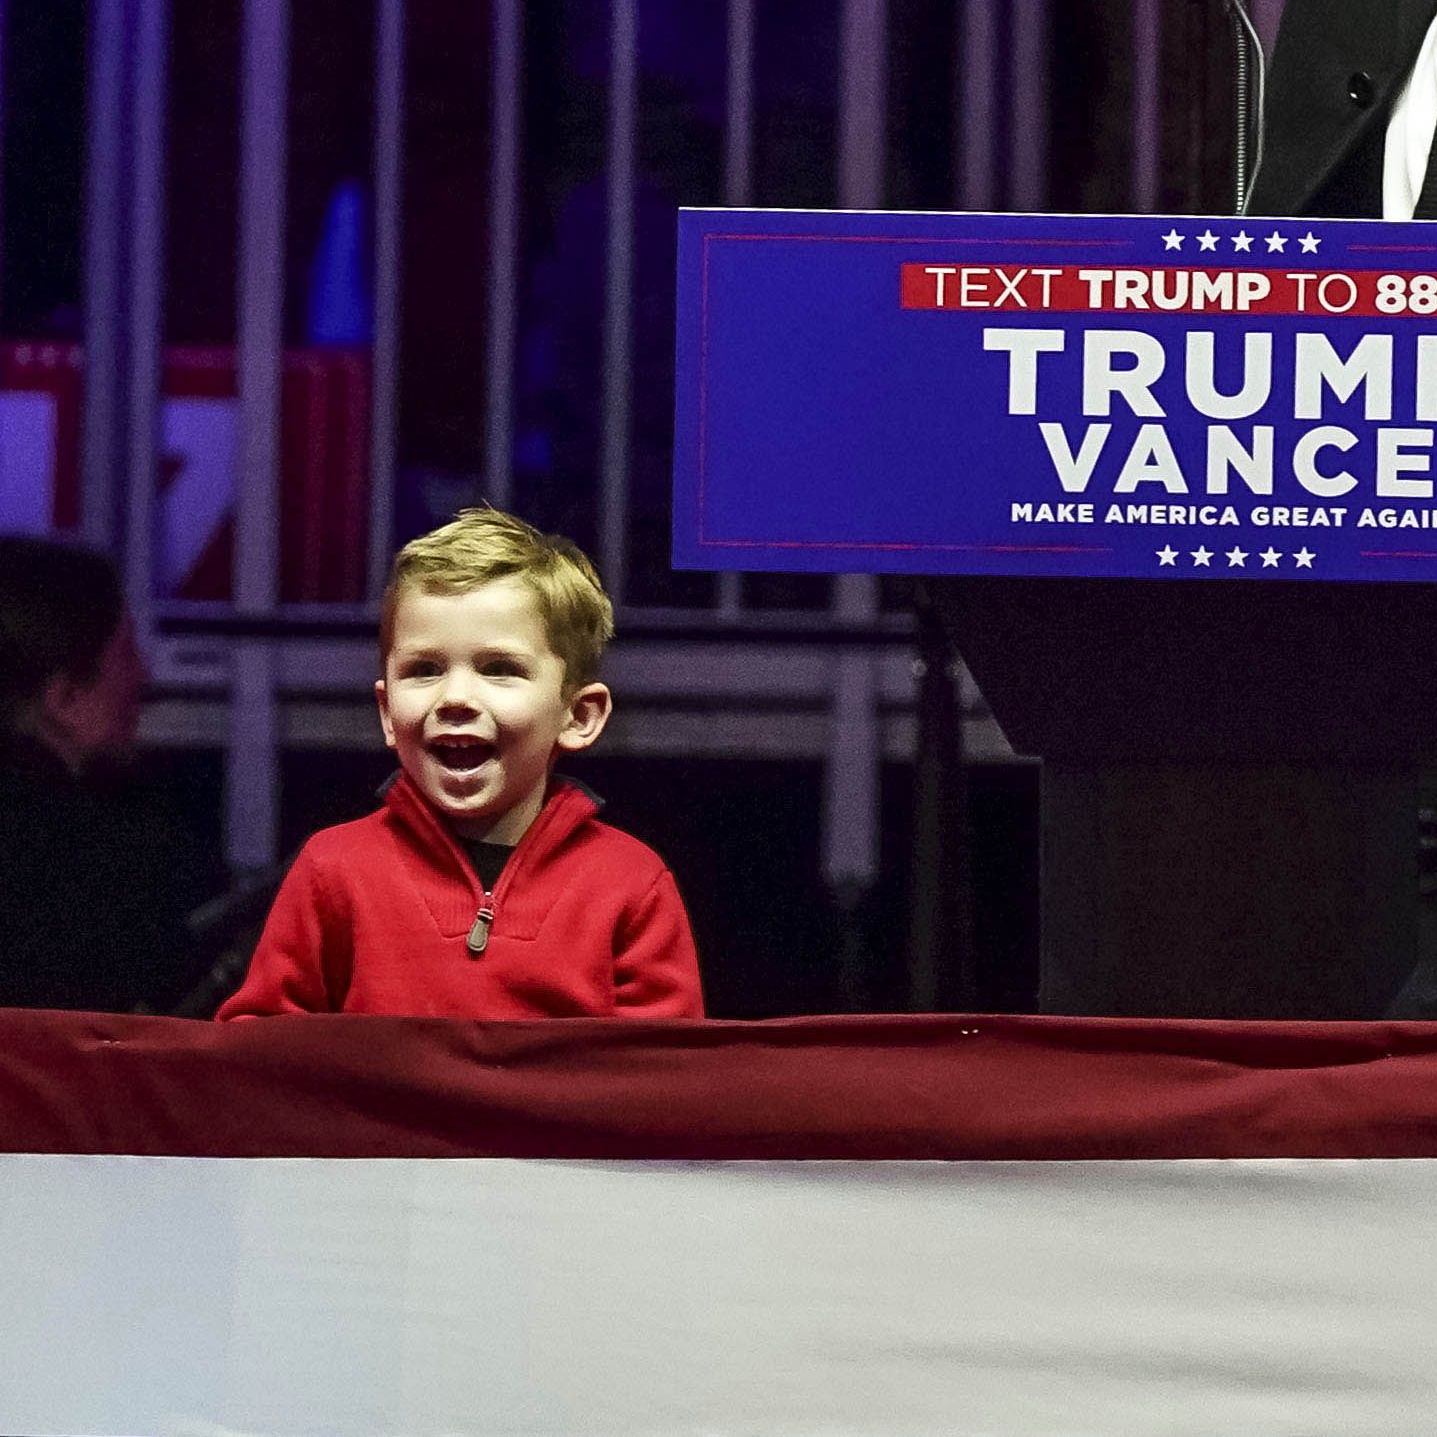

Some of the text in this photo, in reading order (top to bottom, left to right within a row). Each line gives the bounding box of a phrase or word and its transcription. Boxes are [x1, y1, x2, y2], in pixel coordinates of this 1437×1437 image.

[923, 266, 1064, 309] TEXT
[1077, 268, 1272, 312] TRUMP
[1285, 272, 1359, 314] TO
[1037, 421, 1436, 499] VANCE
[1010, 502, 1095, 524] MAKE
[1103, 503, 1241, 527] AMERICA
[1249, 505, 1349, 528] GREAT
